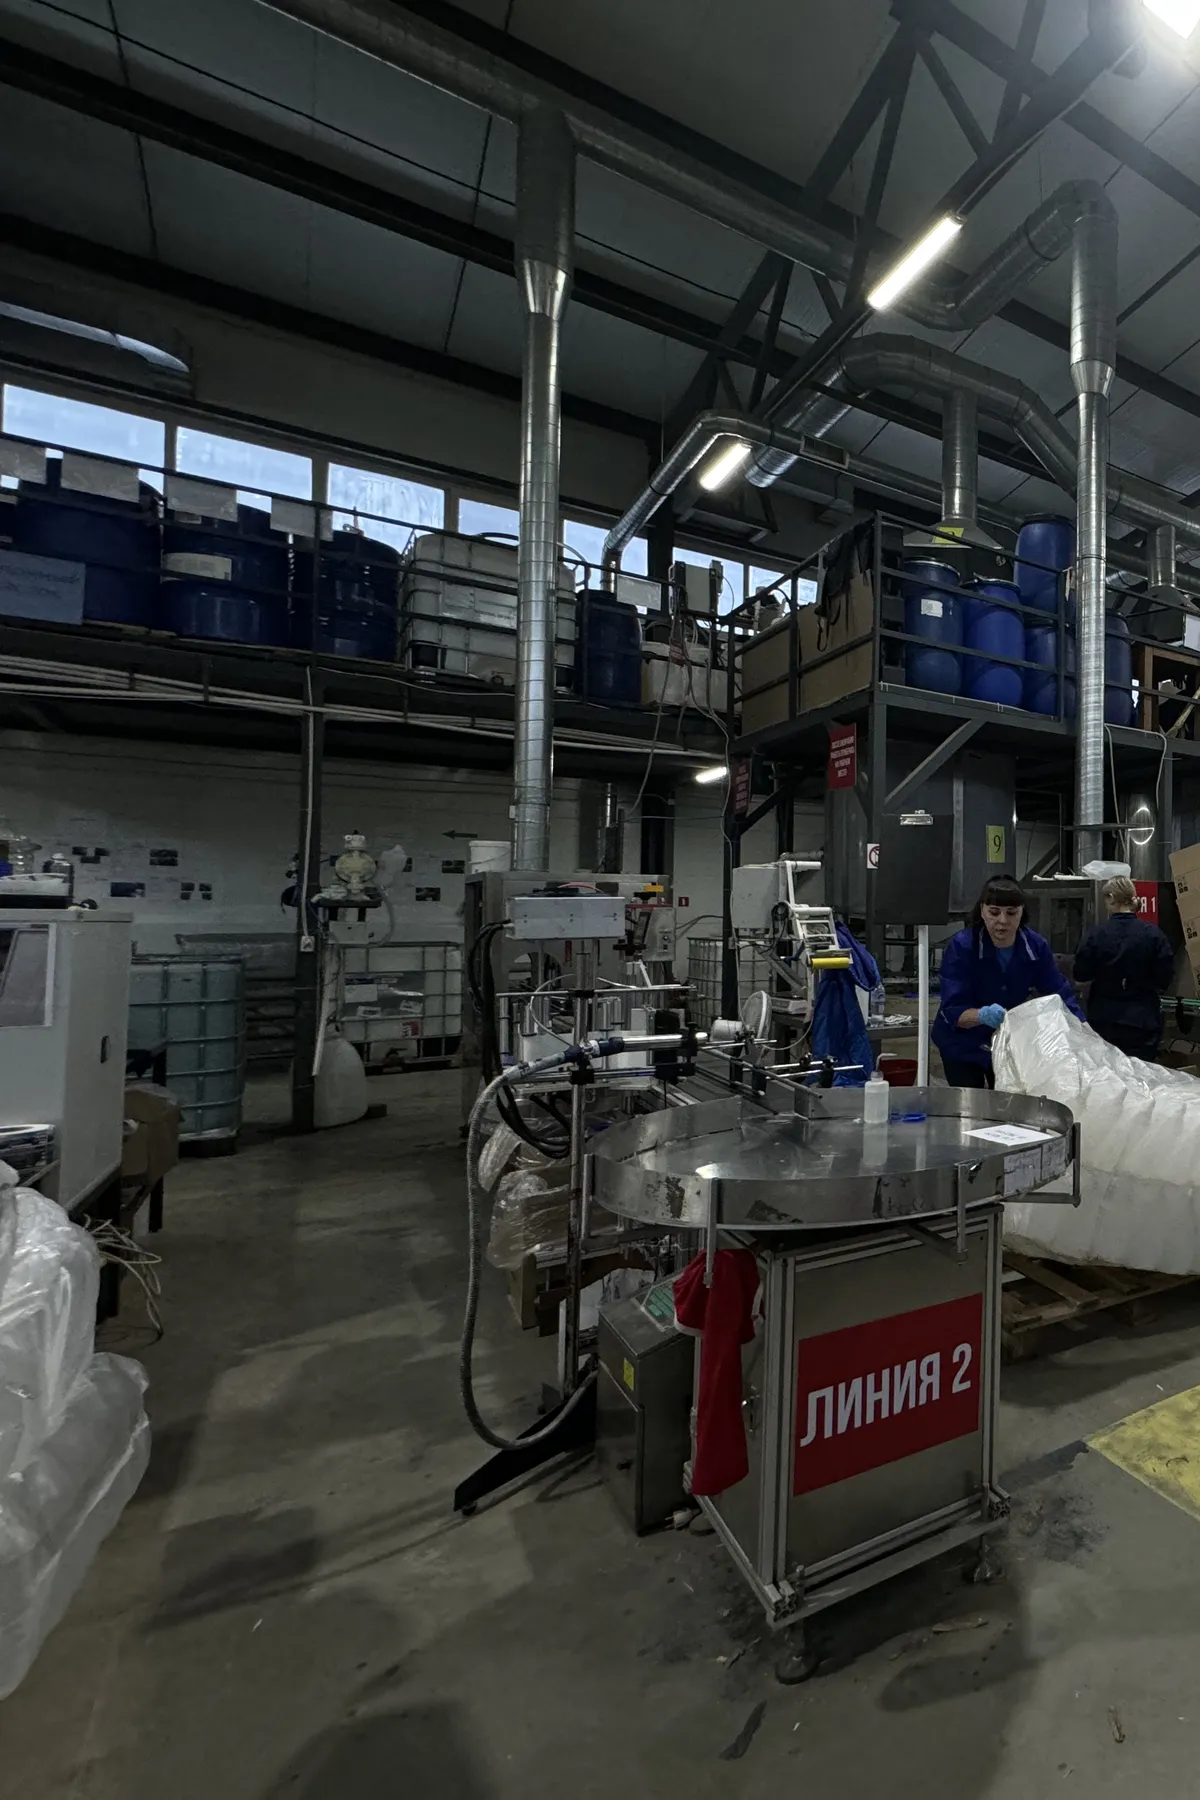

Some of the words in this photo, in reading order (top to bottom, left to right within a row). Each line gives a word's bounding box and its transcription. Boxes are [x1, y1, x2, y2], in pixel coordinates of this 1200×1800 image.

[993, 834, 1002, 854] 9
[1151, 896, 1156, 913] 1
[800, 1352, 940, 1448] ЛИНИЯ
[952, 1342, 973, 1394] 2
